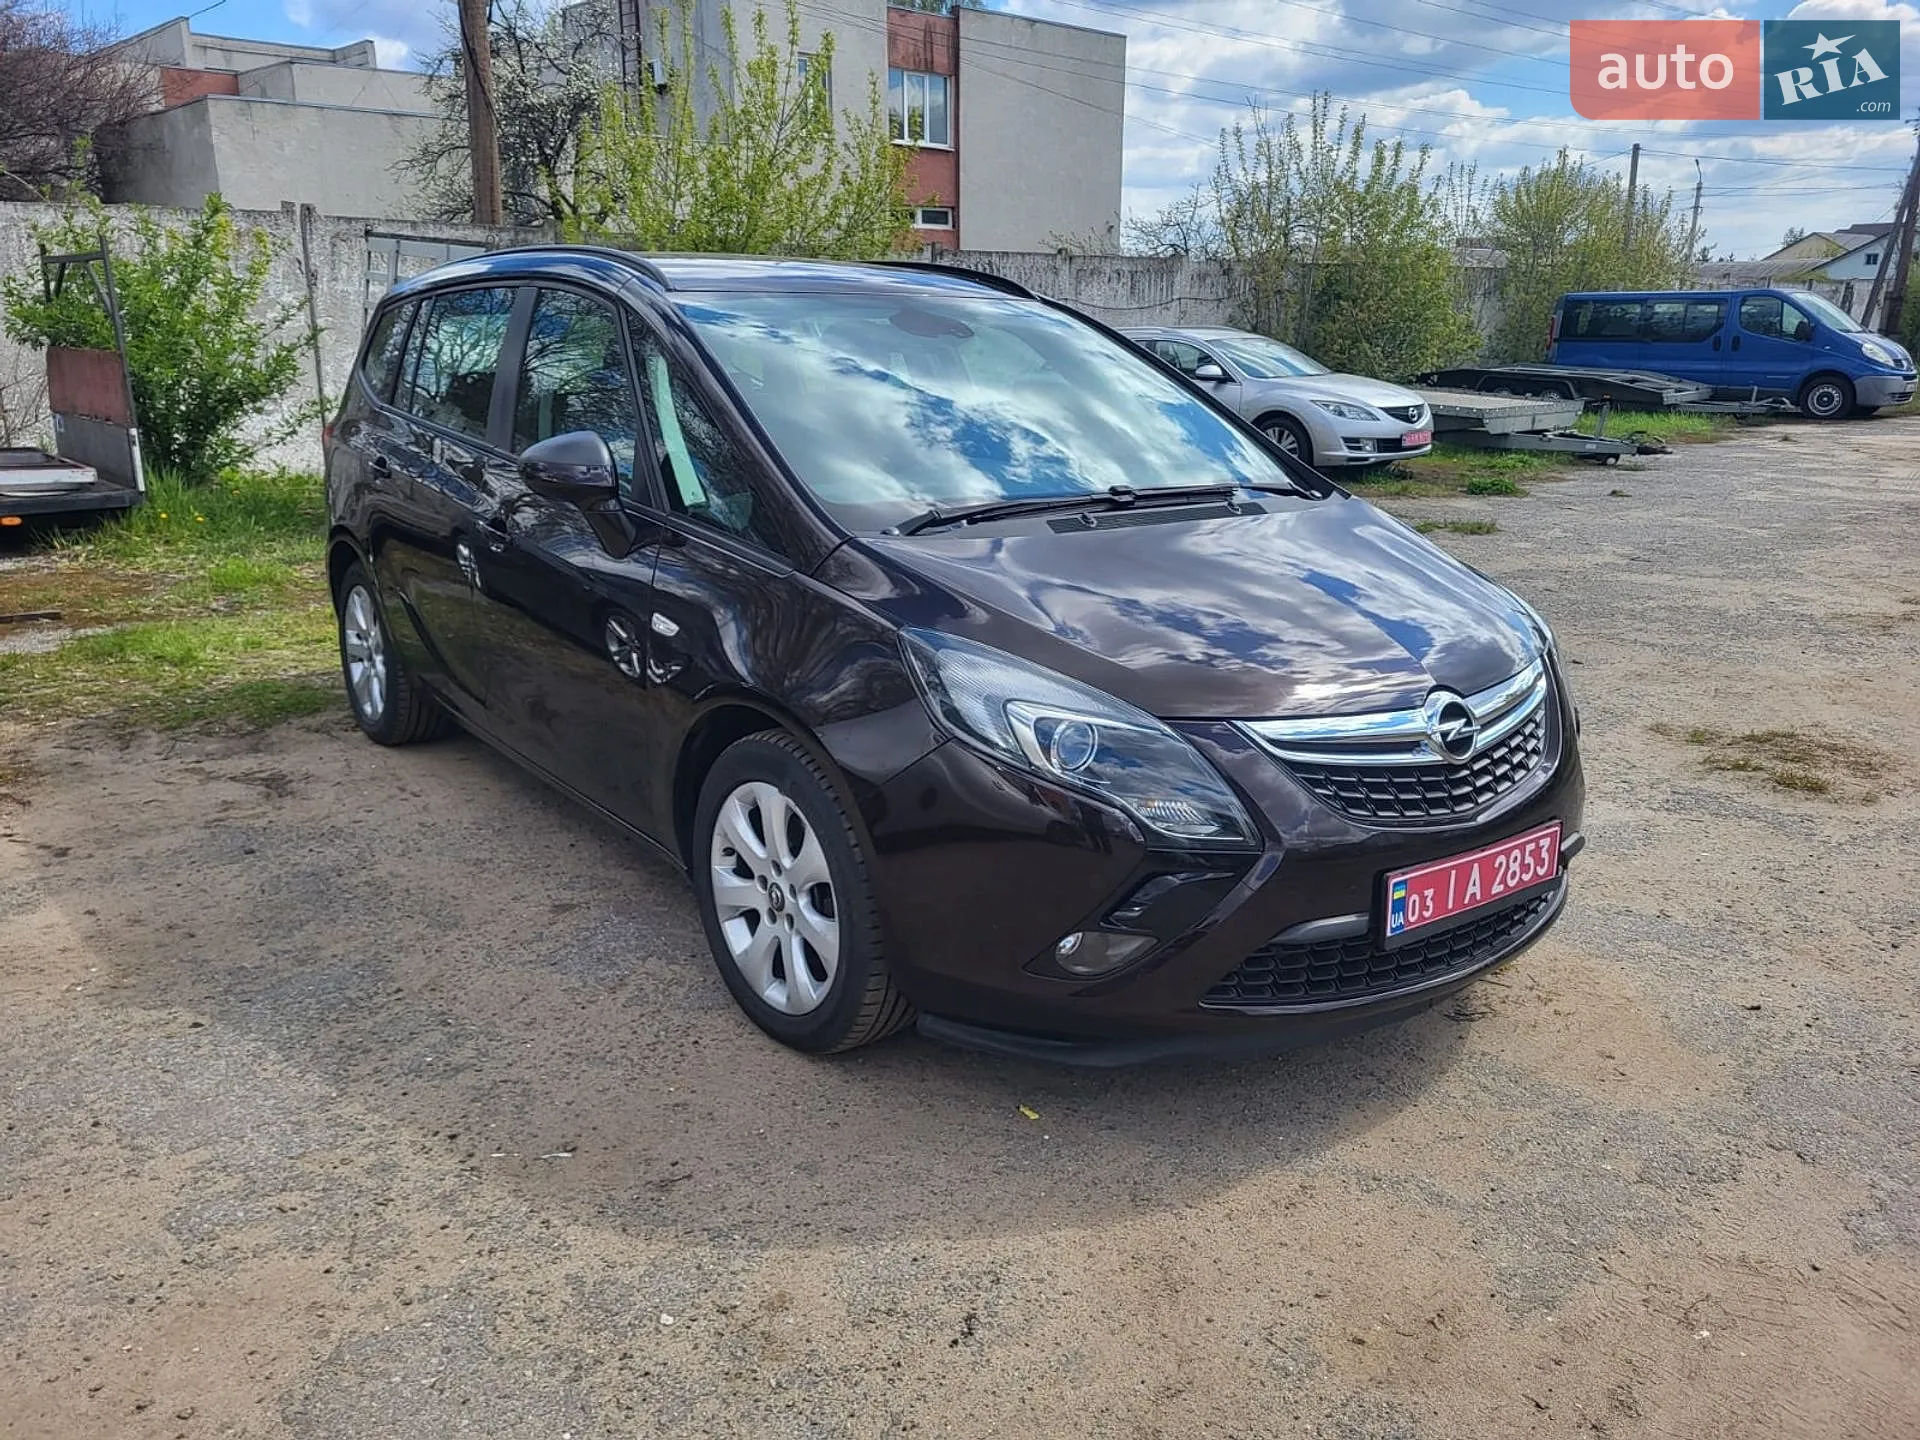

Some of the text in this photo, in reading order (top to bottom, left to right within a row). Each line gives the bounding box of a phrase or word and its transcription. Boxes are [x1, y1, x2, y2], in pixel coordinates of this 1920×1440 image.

[1408, 888, 1435, 923] 03
[1491, 837, 1551, 895] 2853
[1391, 912, 1405, 929] UA
